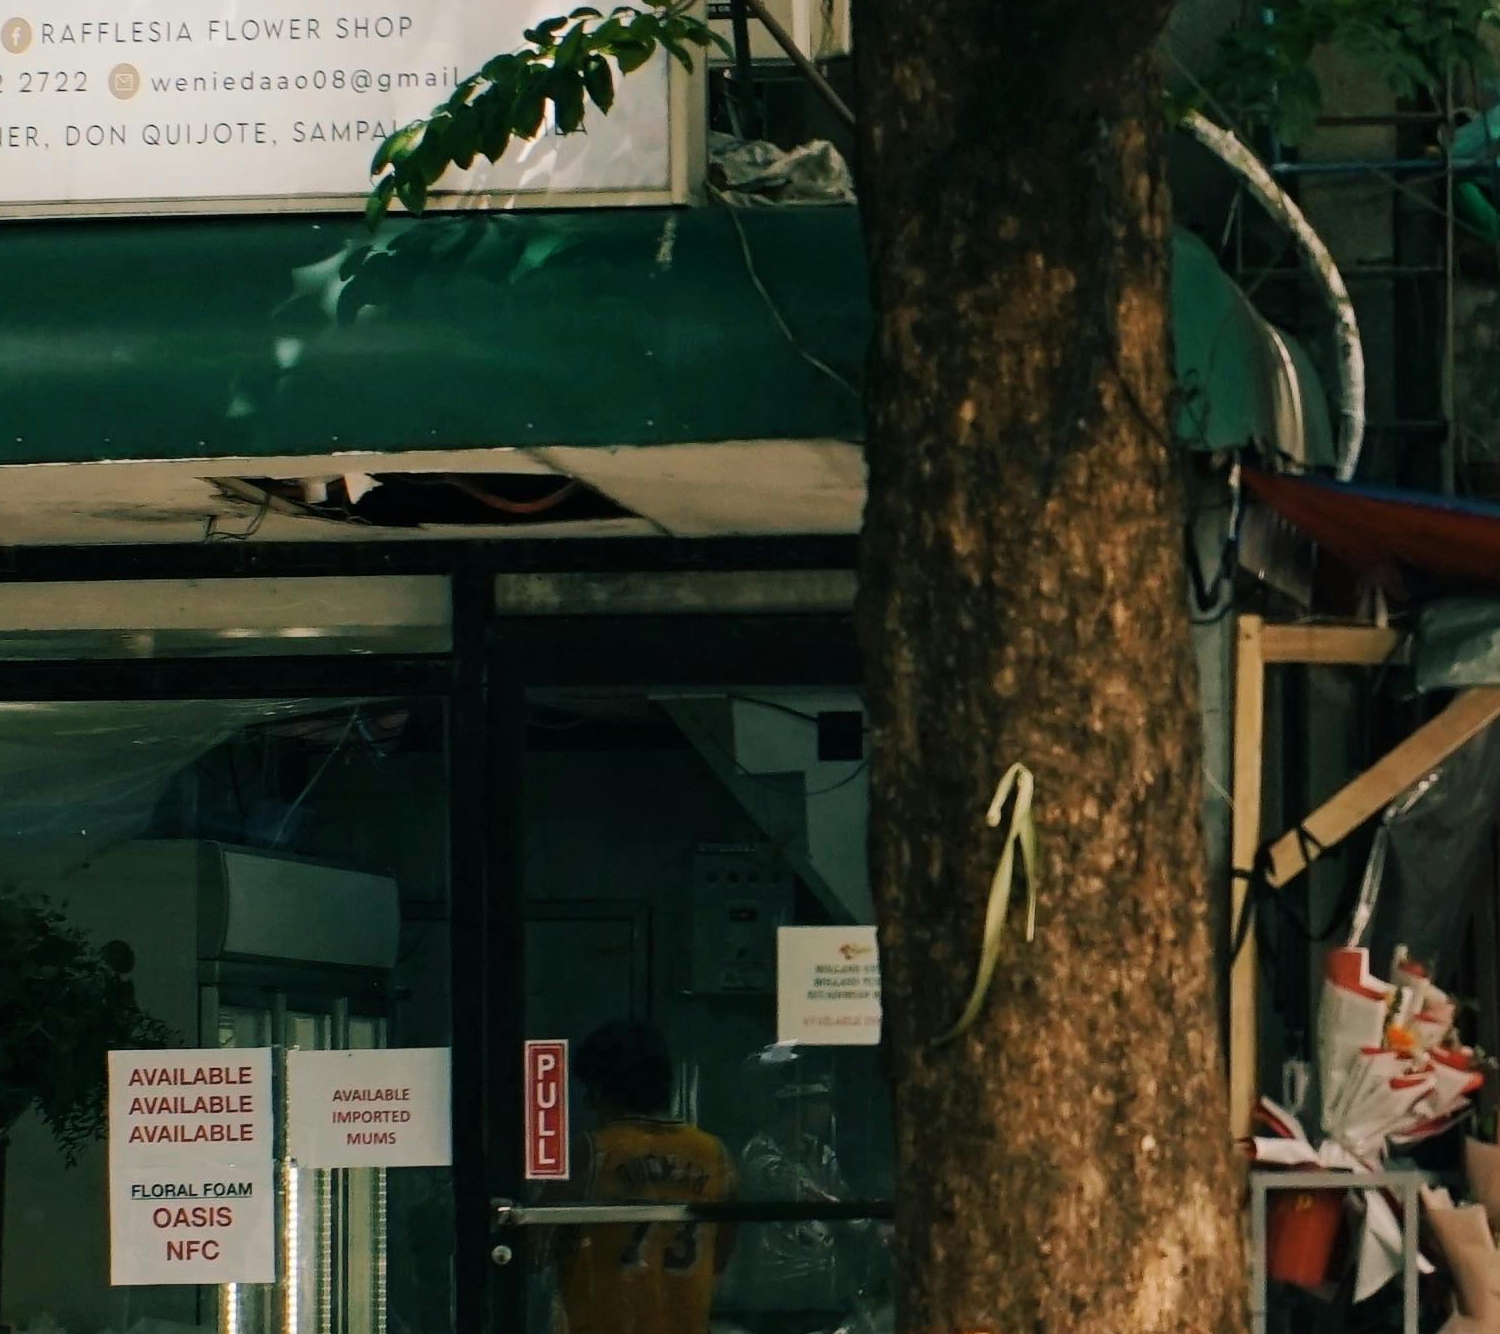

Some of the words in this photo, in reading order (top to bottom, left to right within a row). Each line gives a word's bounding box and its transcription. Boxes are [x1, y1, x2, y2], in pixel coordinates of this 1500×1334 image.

[41, 20, 194, 44] RAFFLESIA
[208, 17, 322, 41] FLOWER
[335, 15, 414, 39] SHOP
[18, 70, 89, 94] 2722
[65, 125, 127, 147] DON
[141, 122, 278, 146] QUIJOTE,
[128, 1066, 254, 1087] AVAILABLE
[128, 1095, 255, 1116] AVAILABLE
[332, 1088, 412, 1102] AVAILABLE
[332, 1110, 411, 1124] IMPORTED
[536, 1053, 557, 1166] PULL
[128, 1123, 255, 1144] AVAILABLE
[346, 1132, 397, 1146] MUMS
[131, 1182, 197, 1198] FLORAL
[203, 1182, 254, 1197] FOAM
[152, 1206, 233, 1229] OASIS
[166, 1240, 221, 1261] NFC
